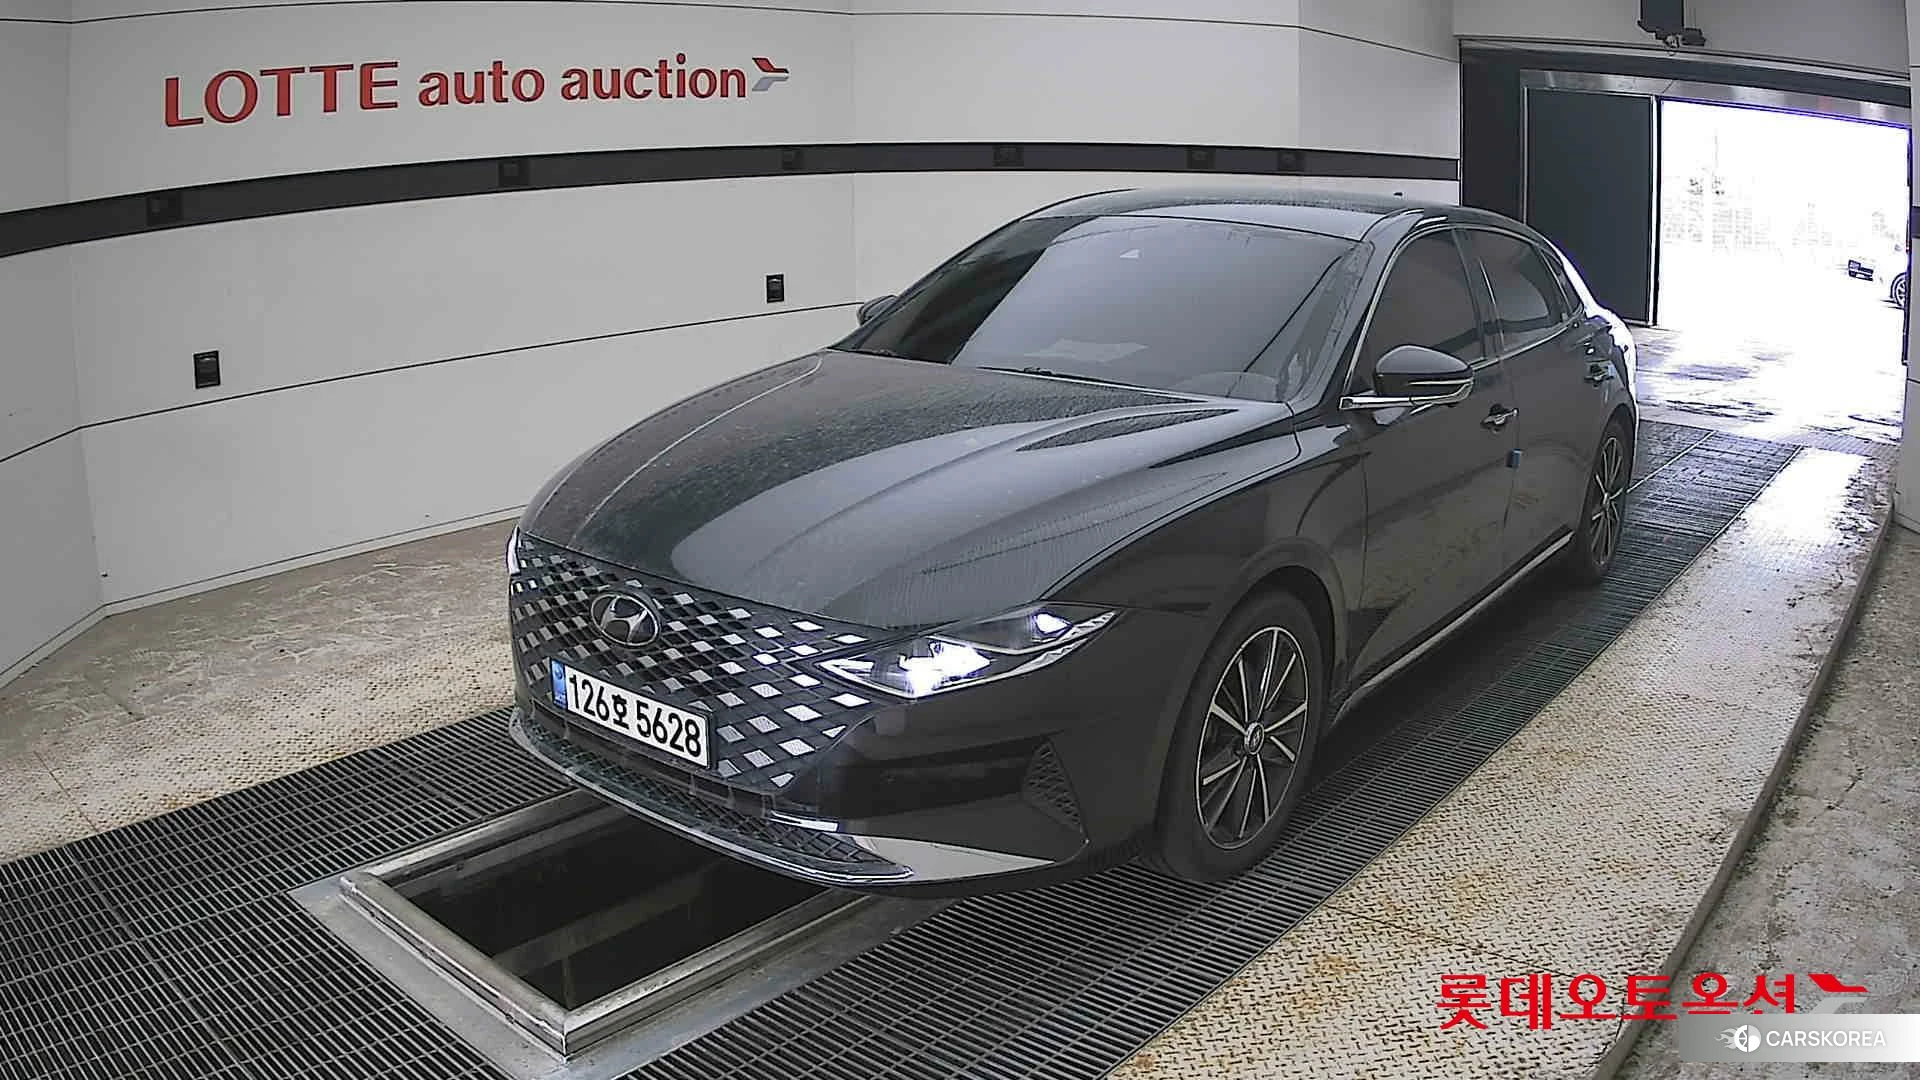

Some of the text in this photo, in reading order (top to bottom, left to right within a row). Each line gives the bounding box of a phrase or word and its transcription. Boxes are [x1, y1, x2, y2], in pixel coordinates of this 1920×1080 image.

[165, 53, 747, 127] LOTTE auto auction
[569, 674, 701, 757] 126호 5628
